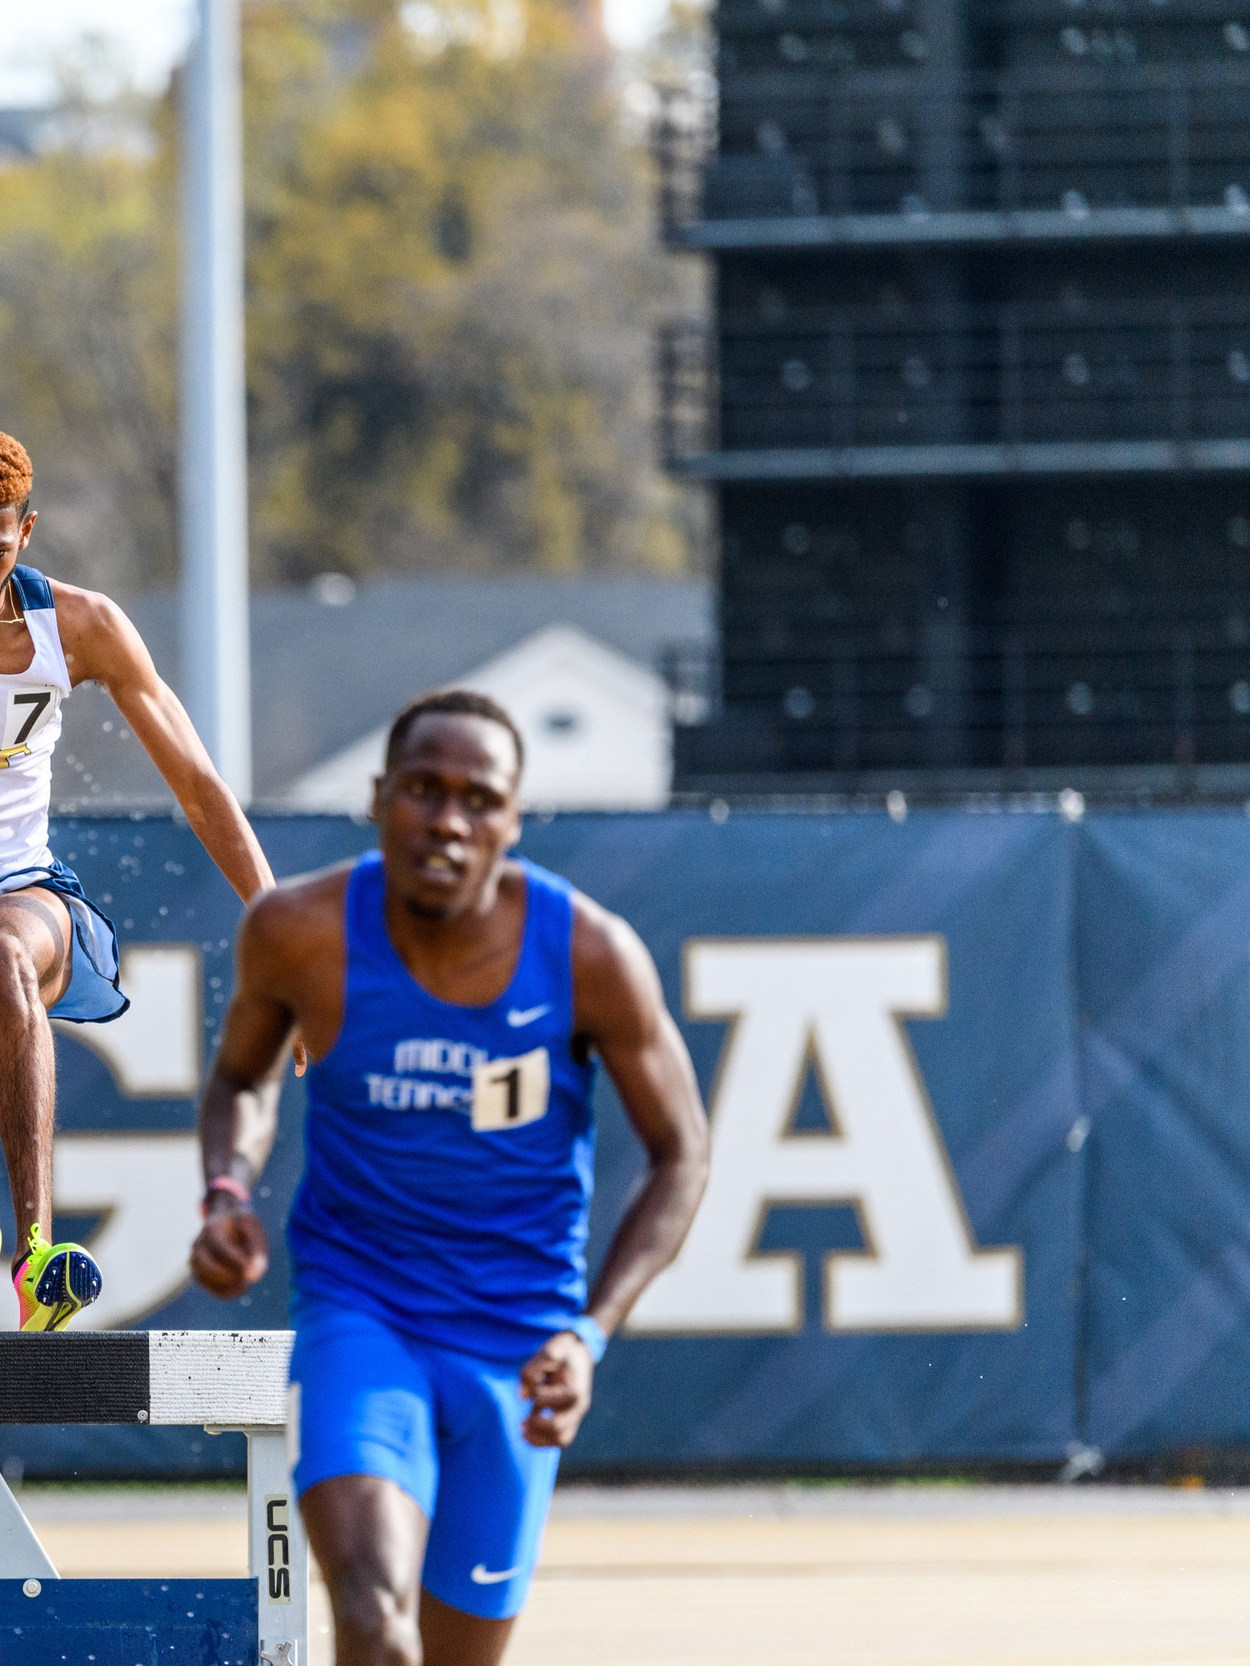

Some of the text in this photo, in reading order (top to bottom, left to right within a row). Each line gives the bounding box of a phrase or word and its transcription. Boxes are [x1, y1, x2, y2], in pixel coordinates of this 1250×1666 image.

[13, 691, 51, 745] 7
[490, 1068, 521, 1119] 1
[266, 1499, 290, 1599] UCS
